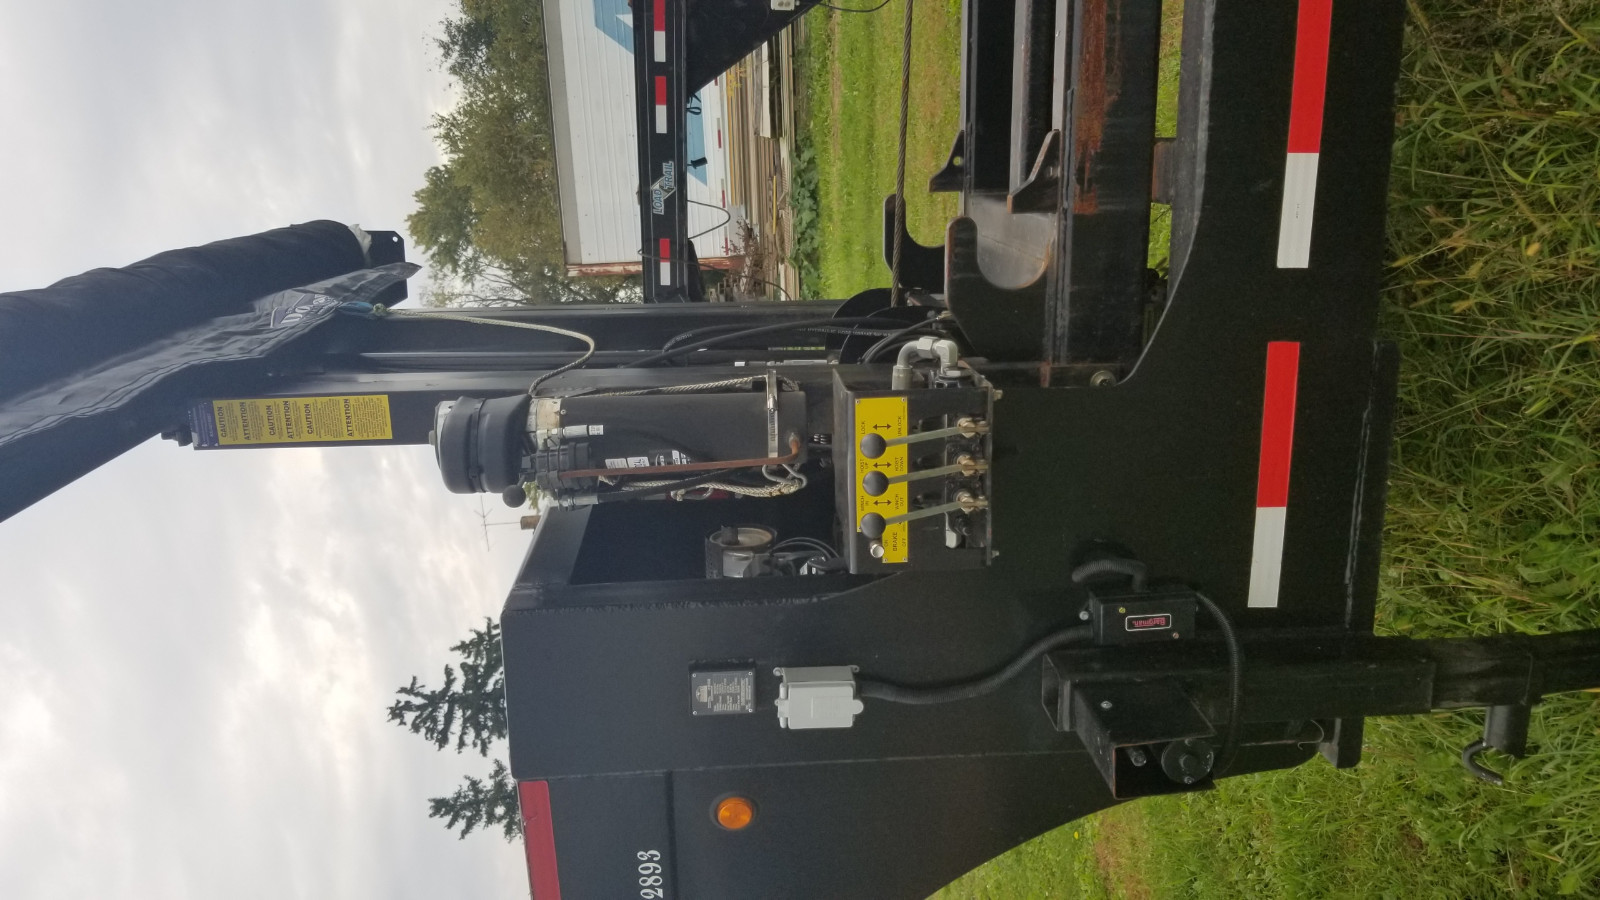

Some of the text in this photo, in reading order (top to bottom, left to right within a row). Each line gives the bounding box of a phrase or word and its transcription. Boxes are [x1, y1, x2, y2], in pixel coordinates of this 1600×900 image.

[662, 160, 674, 189] TRAIL
[652, 189, 664, 215] LOAD
[217, 407, 227, 437] CAUTION
[239, 402, 251, 440] ATTENTION
[266, 405, 275, 435] CAUTION
[283, 400, 294, 439] ATTENTION
[304, 404, 314, 434] CAUTION
[343, 399, 353, 436] ATTENTION
[637, 850, 663, 899] 2893
